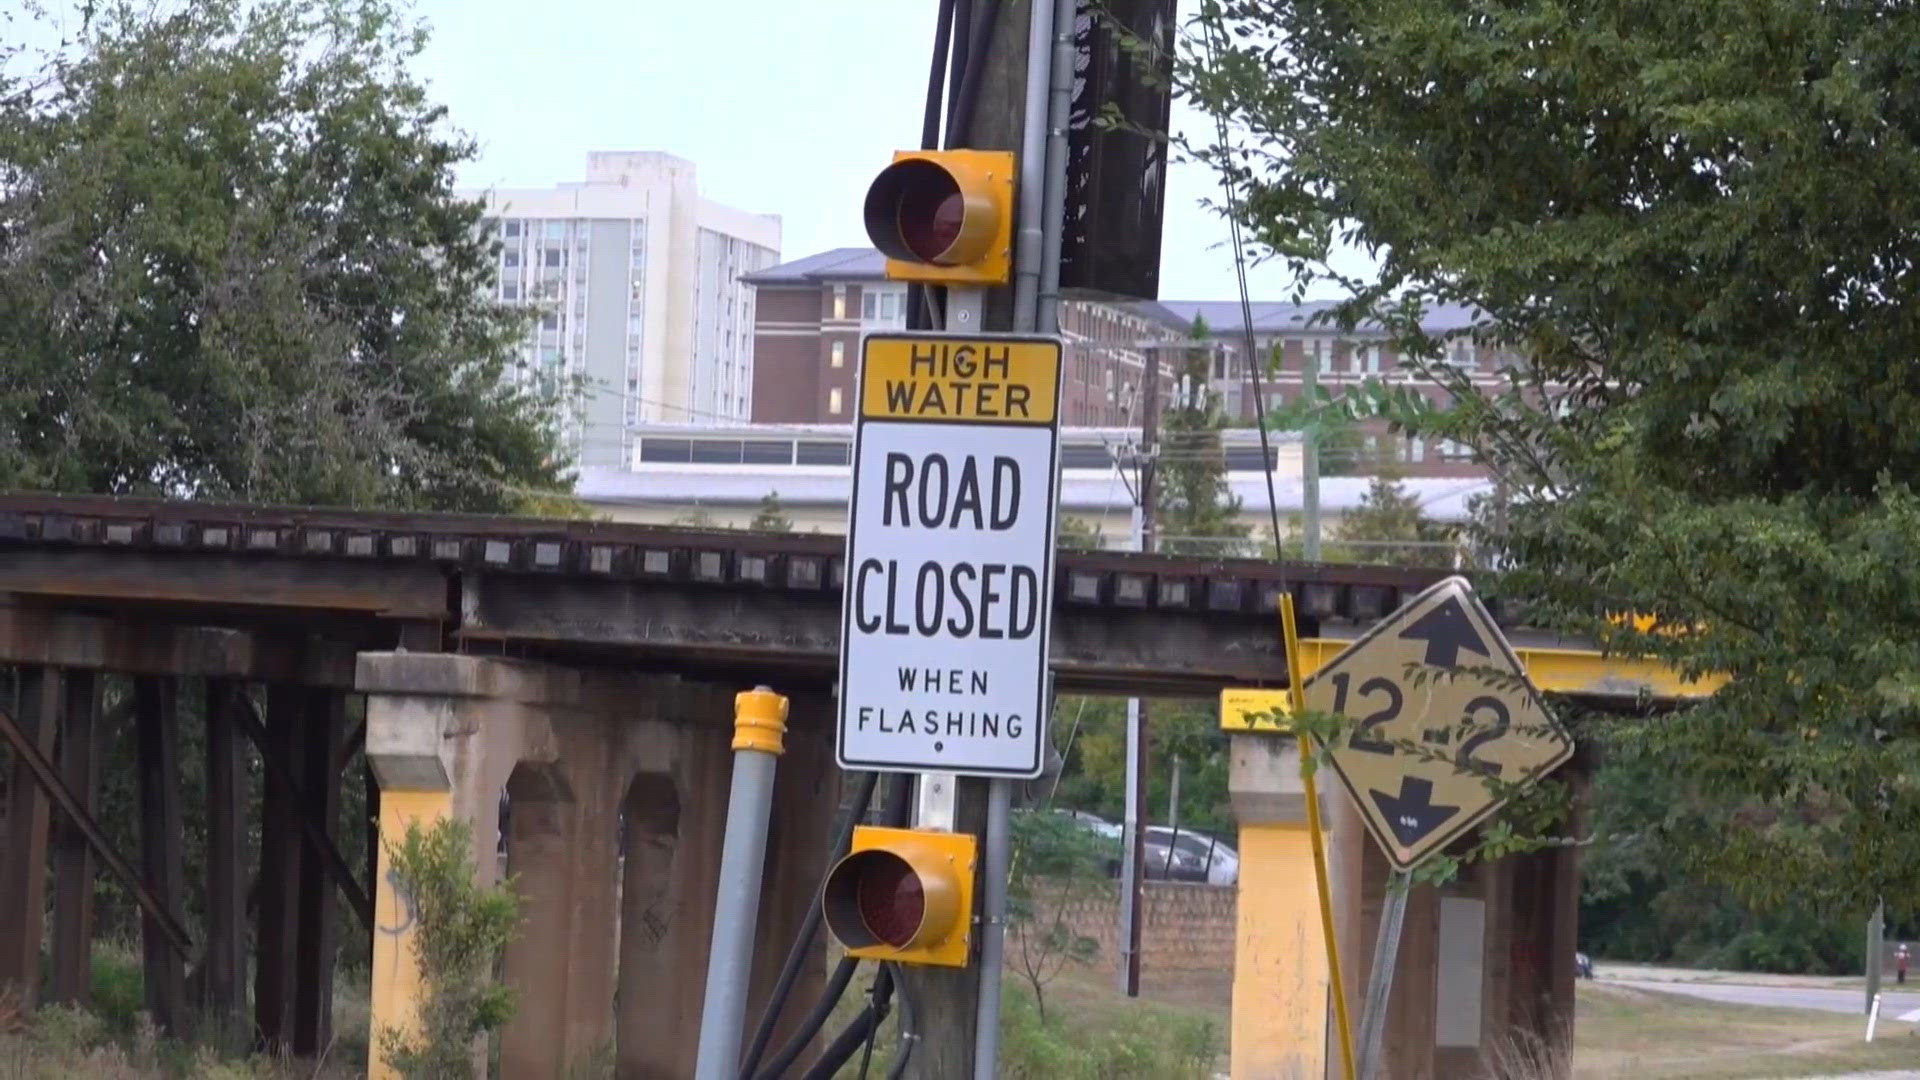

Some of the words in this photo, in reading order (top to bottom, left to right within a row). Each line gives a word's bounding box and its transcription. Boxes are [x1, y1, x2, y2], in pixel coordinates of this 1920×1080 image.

[910, 344, 1010, 379] HIGH
[886, 380, 1031, 417] WATER
[883, 452, 1021, 530] ROAD
[855, 558, 1038, 639] CLOSED
[898, 667, 988, 695] WHEN
[858, 707, 1023, 738] FLASHING
